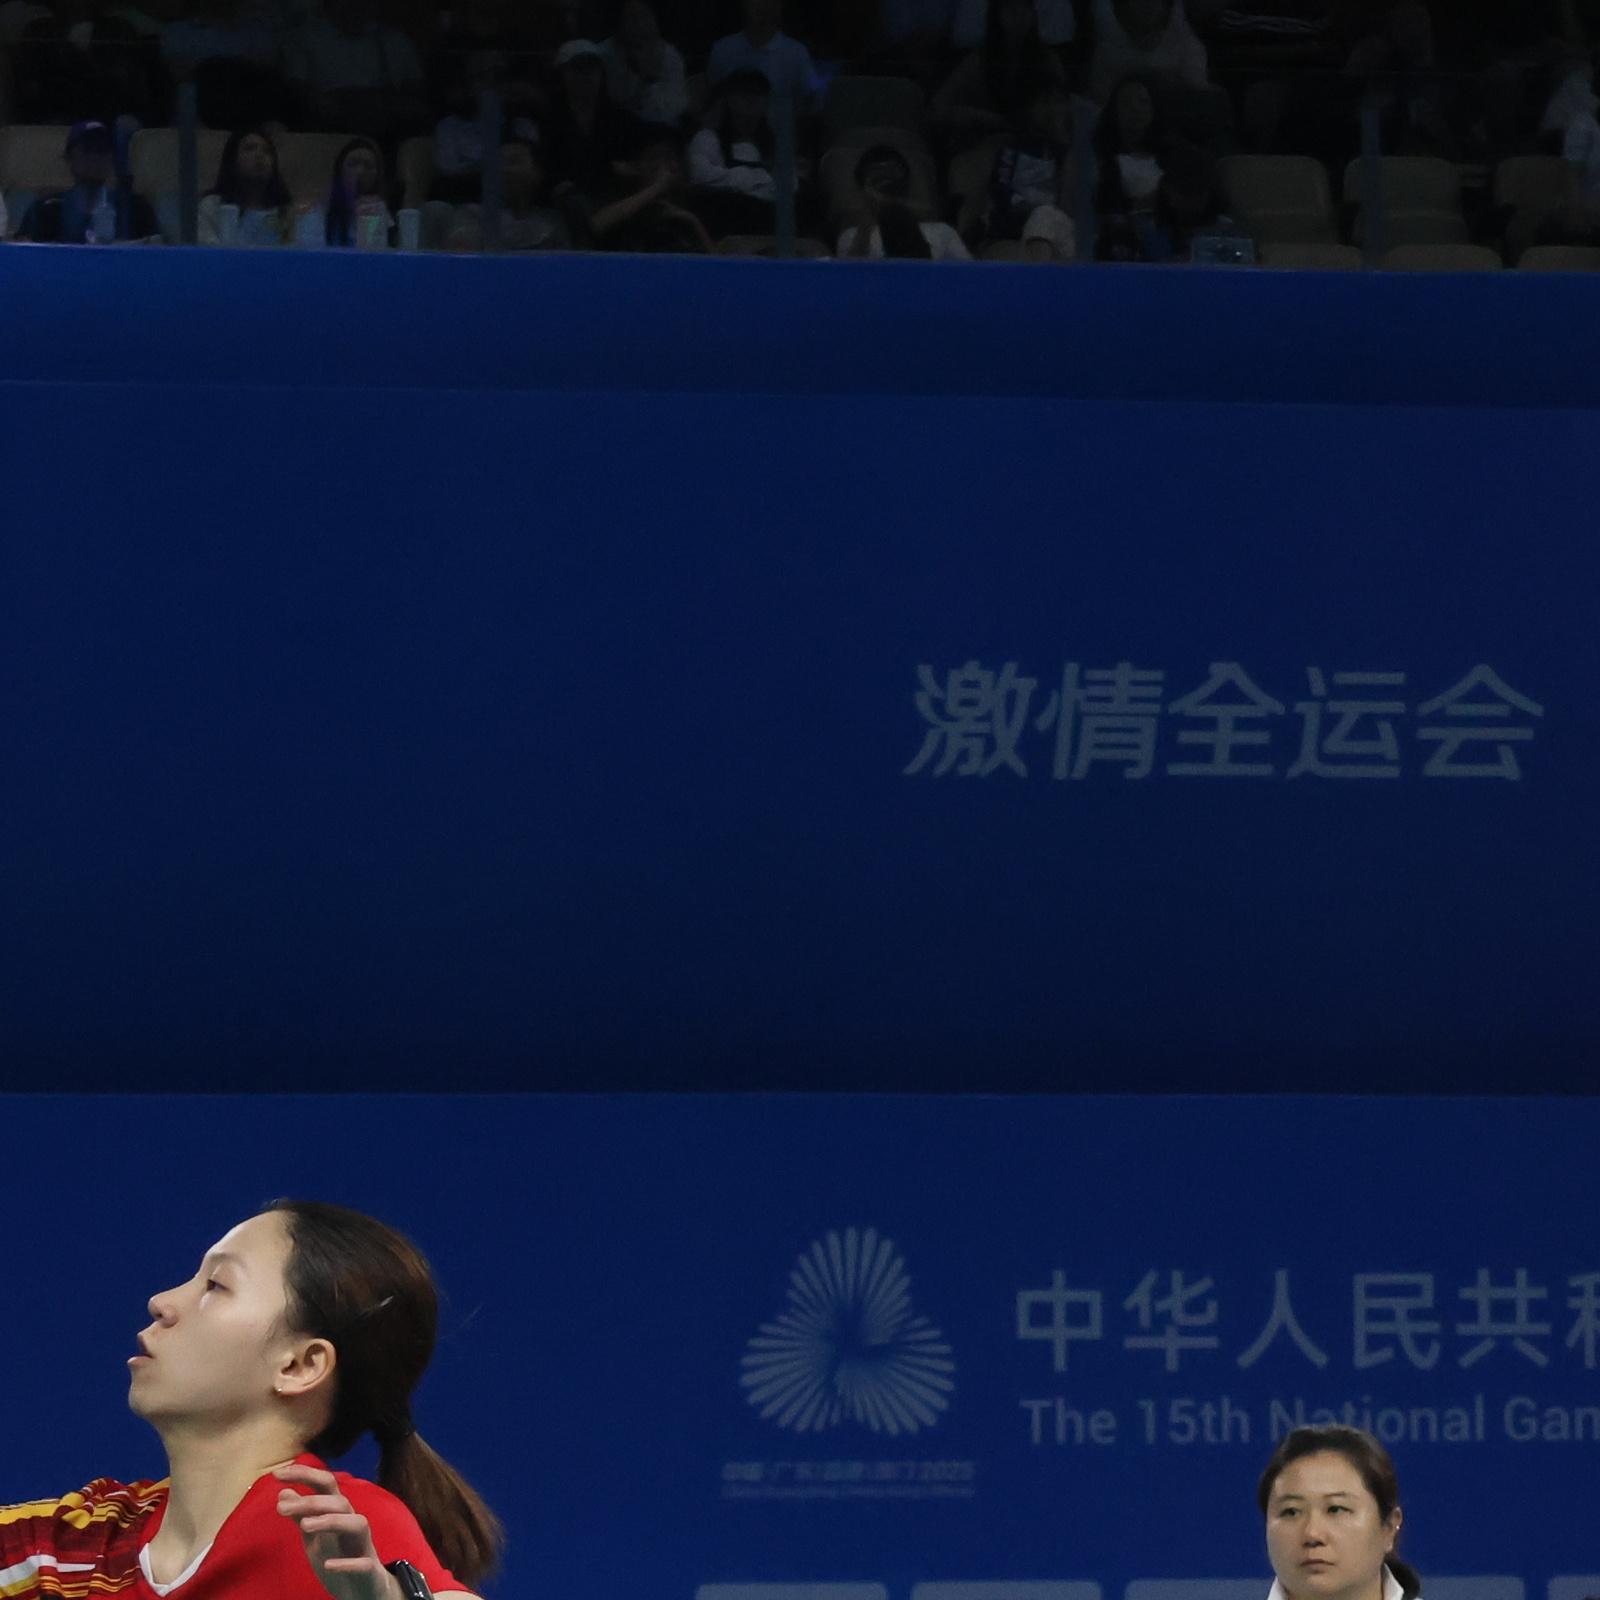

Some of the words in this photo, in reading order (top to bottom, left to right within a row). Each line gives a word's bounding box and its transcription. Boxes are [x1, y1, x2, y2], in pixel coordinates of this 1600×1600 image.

[902, 660, 1544, 781] 激情全运会
[1019, 1397, 1118, 1446] The
[1136, 1396, 1250, 1445] 15th
